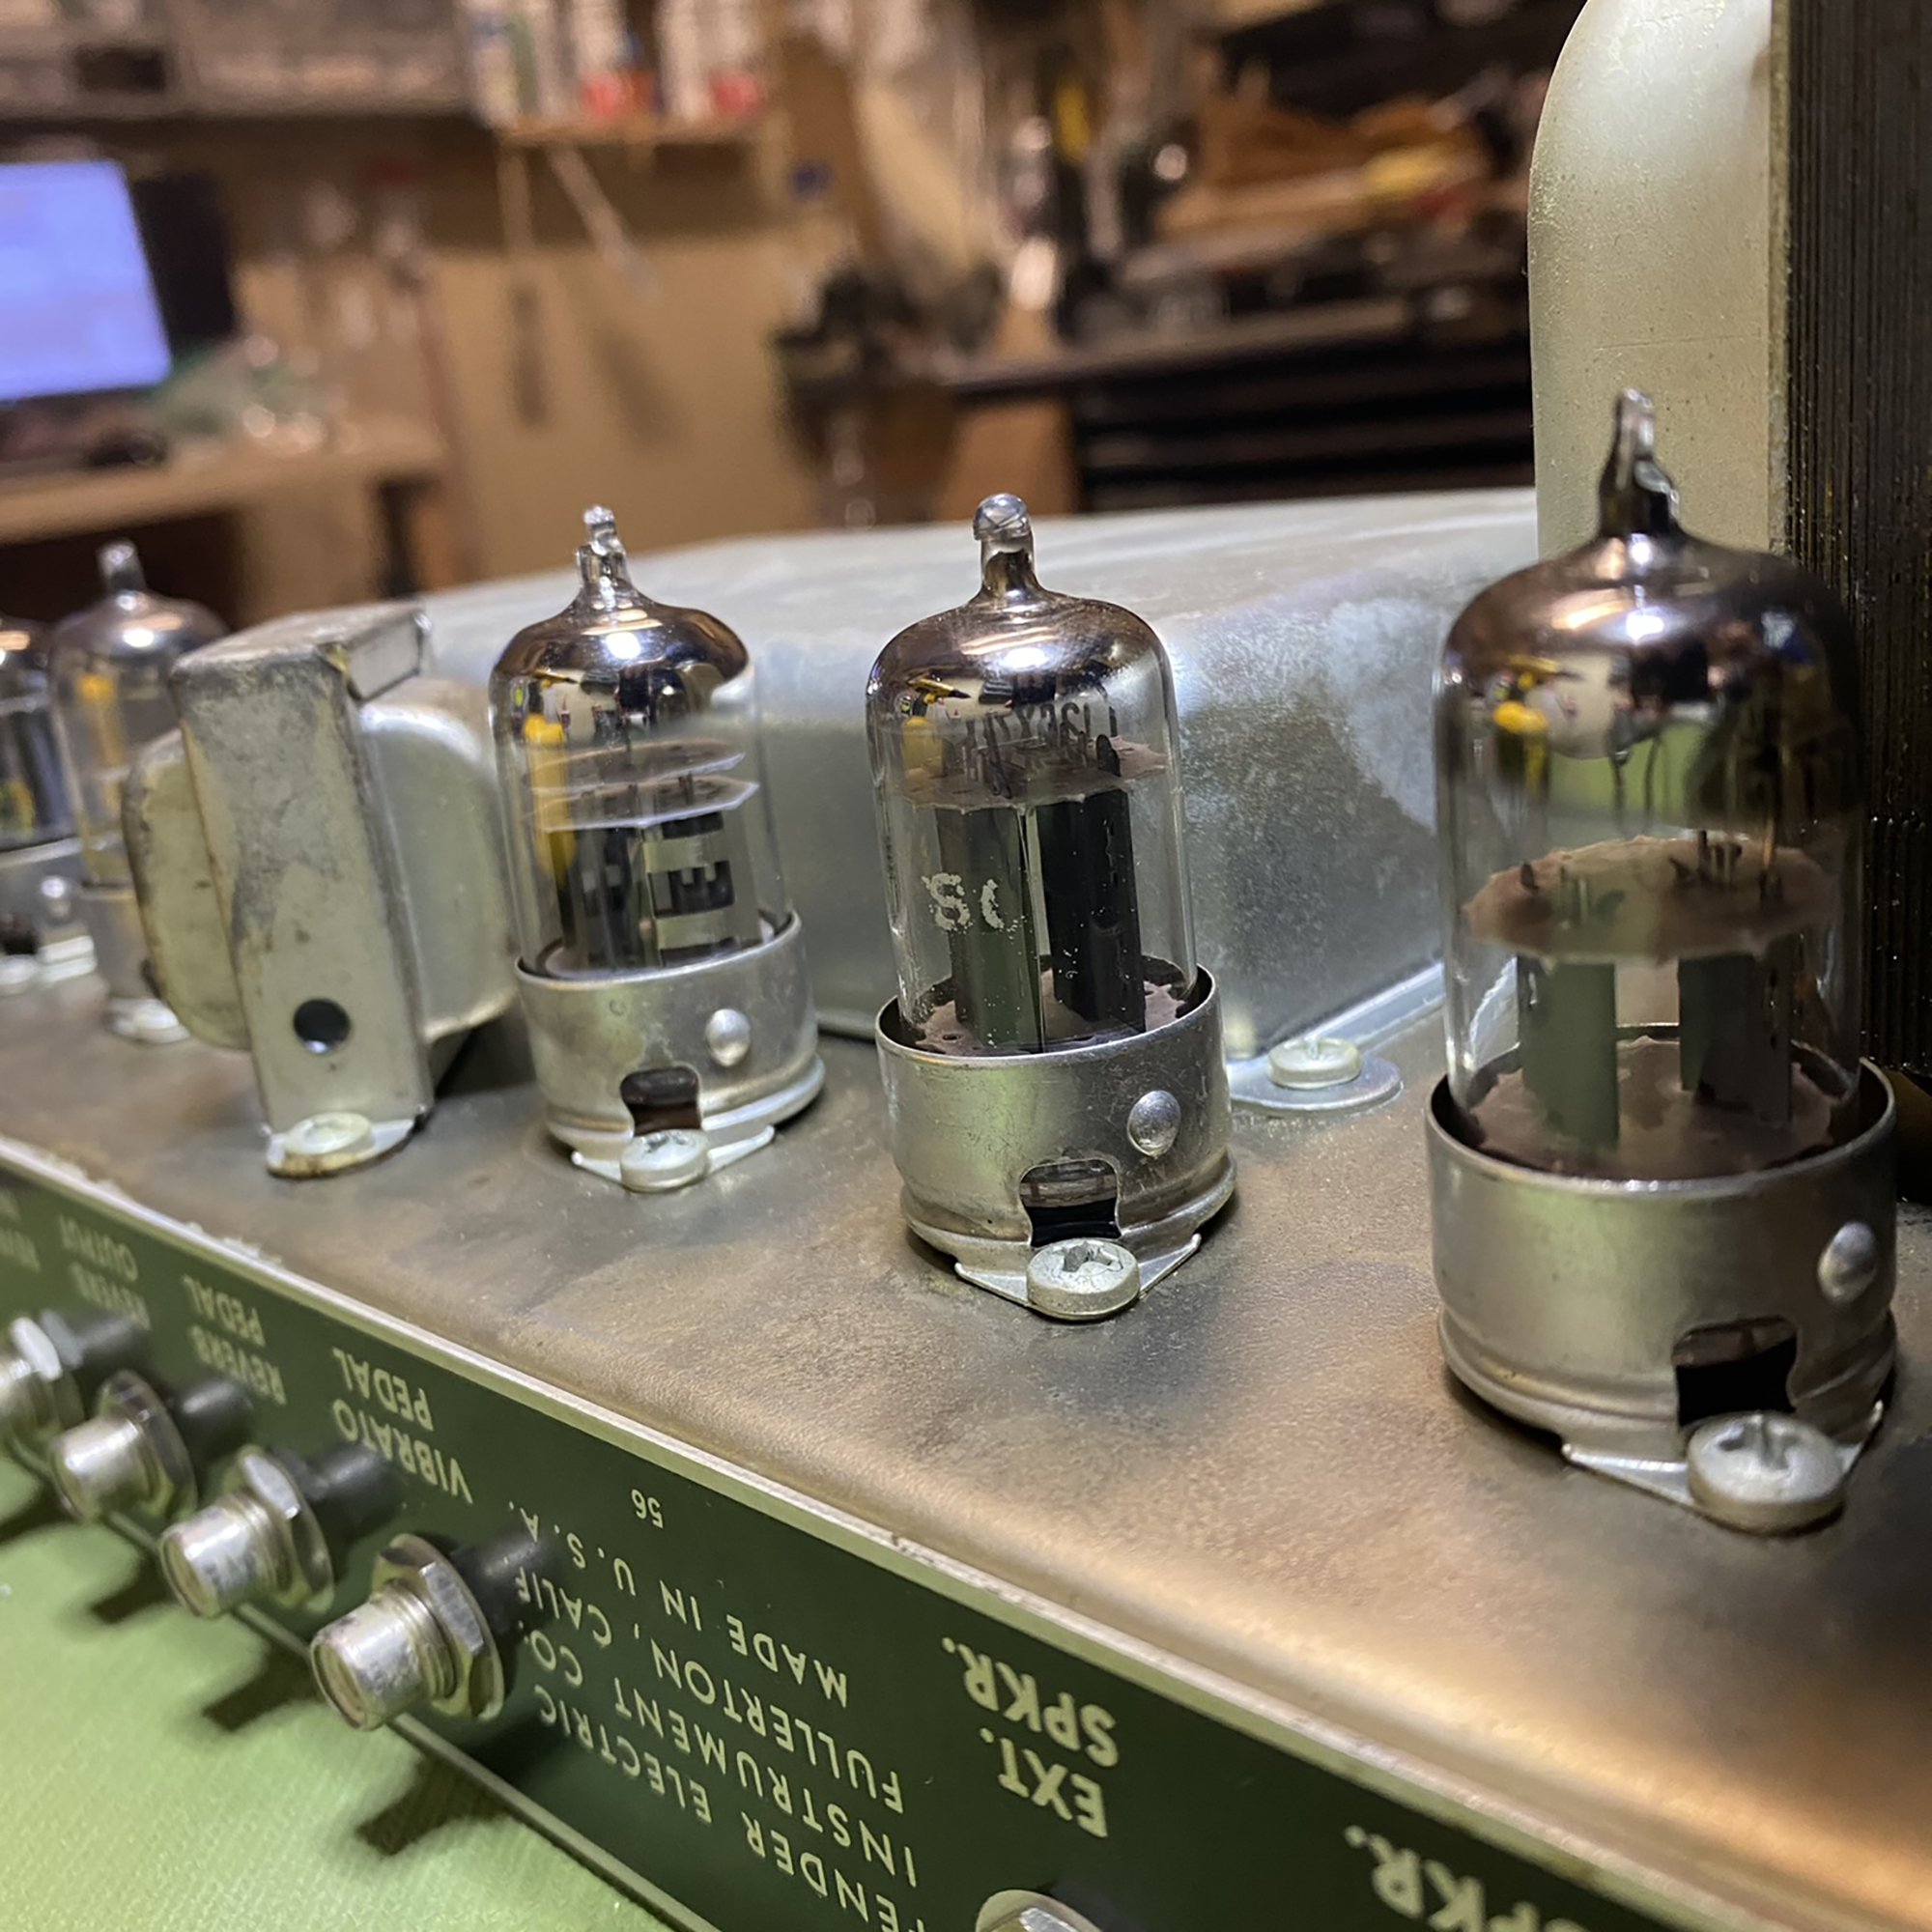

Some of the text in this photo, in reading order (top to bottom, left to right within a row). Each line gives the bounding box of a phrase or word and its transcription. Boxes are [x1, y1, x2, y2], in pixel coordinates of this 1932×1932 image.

[182, 1275, 265, 1348] PEDAL
[190, 1324, 287, 1406] REVERB
[330, 1347, 433, 1432] PEDAL
[329, 1399, 473, 1504] VIBRATO
[630, 1489, 665, 1530] 56
[659, 1579, 702, 1632] IN
[503, 1555, 903, 1814] FULLERTON, CALIF.
[724, 1614, 848, 1708] MADE
[941, 1636, 1119, 1767] SPKR.
[518, 1620, 917, 1889] INSTRUMENT CO.
[532, 1684, 712, 1825] ELECTRIC
[979, 1727, 1108, 1838] EXT.
